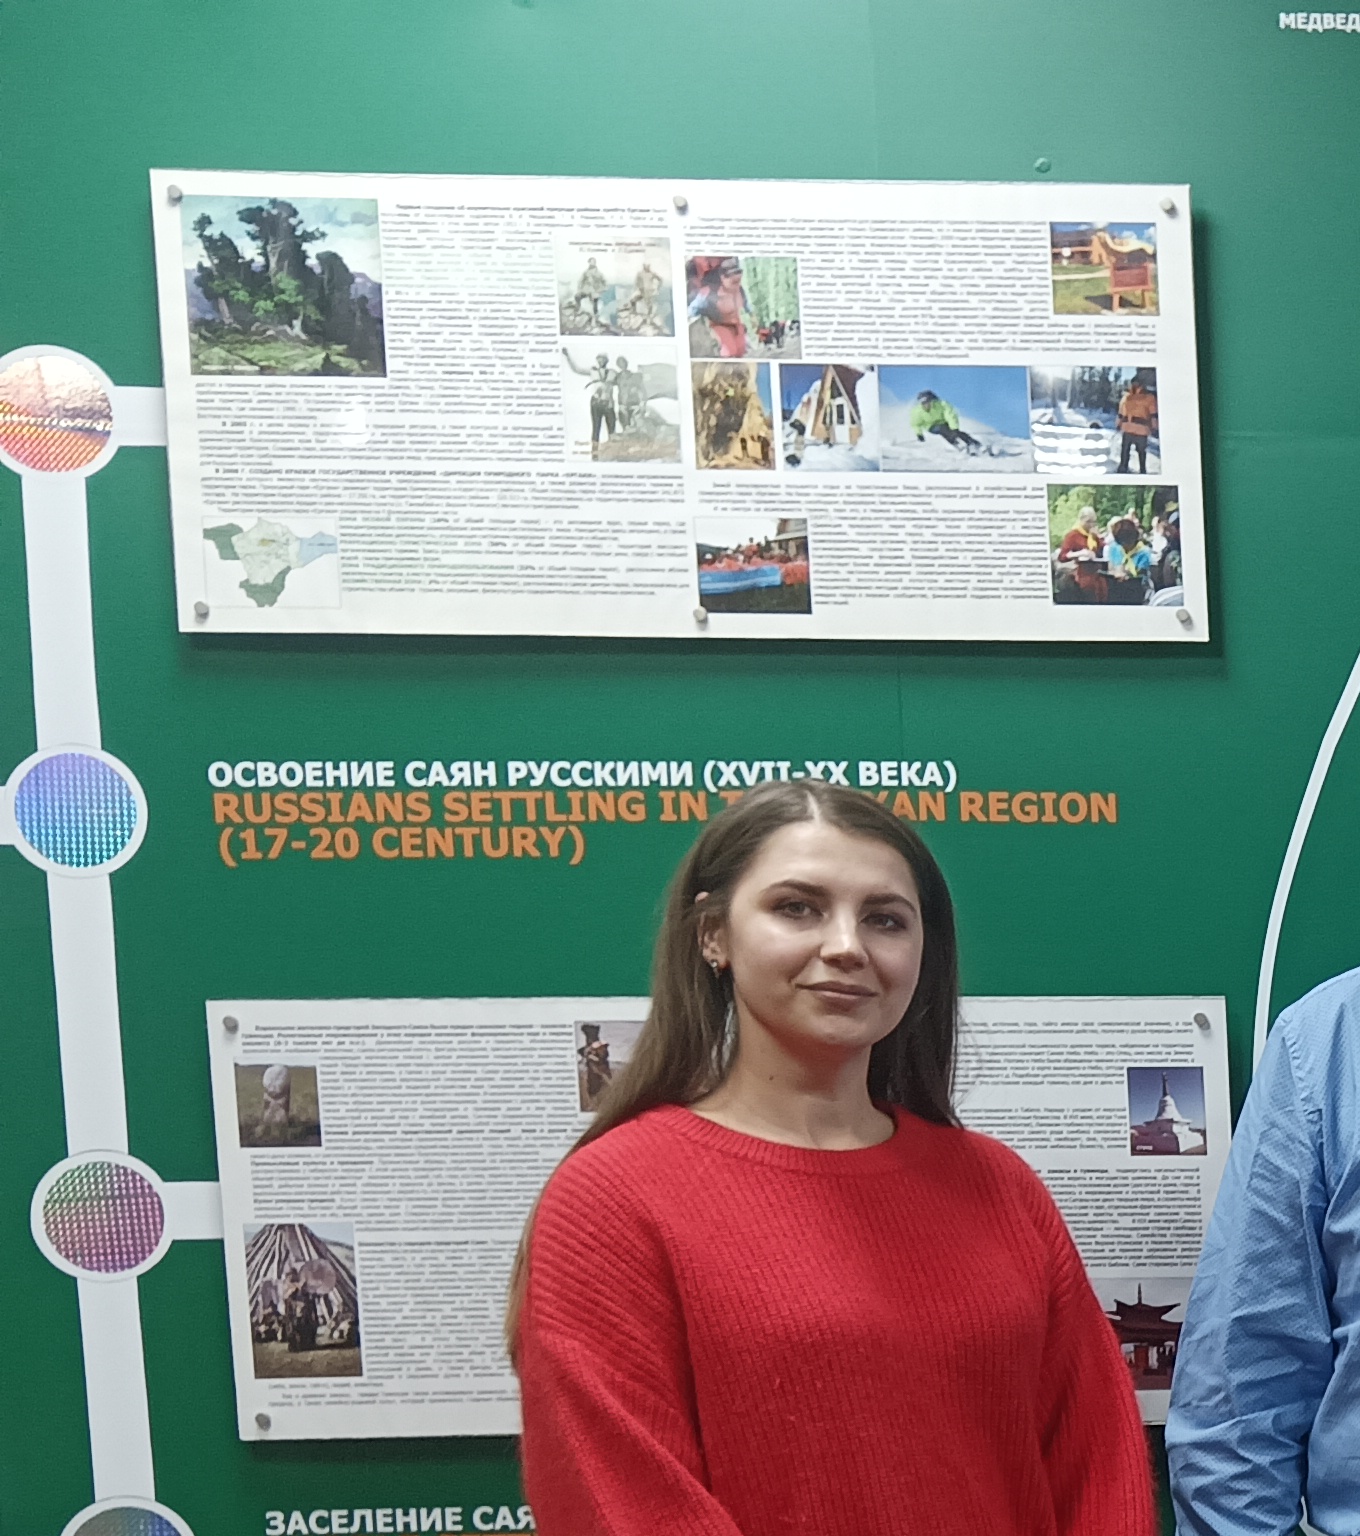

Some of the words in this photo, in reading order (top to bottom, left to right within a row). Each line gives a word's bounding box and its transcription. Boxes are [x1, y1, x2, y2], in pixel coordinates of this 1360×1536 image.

[207, 760, 396, 788] ОСВОЕНИЕ
[404, 760, 498, 788] САЯН
[507, 760, 694, 788] РУССКИМИ
[858, 760, 957, 793] ВЕКА)
[213, 791, 432, 824] RUSSIANS
[443, 790, 647, 823] SETTLING
[658, 790, 708, 822] IN
[959, 791, 1117, 824] REGION
[219, 826, 360, 868] (17-20
[371, 824, 585, 865] CENTURY)
[264, 1504, 465, 1536] ЗАСЕЛЕНИЕ
